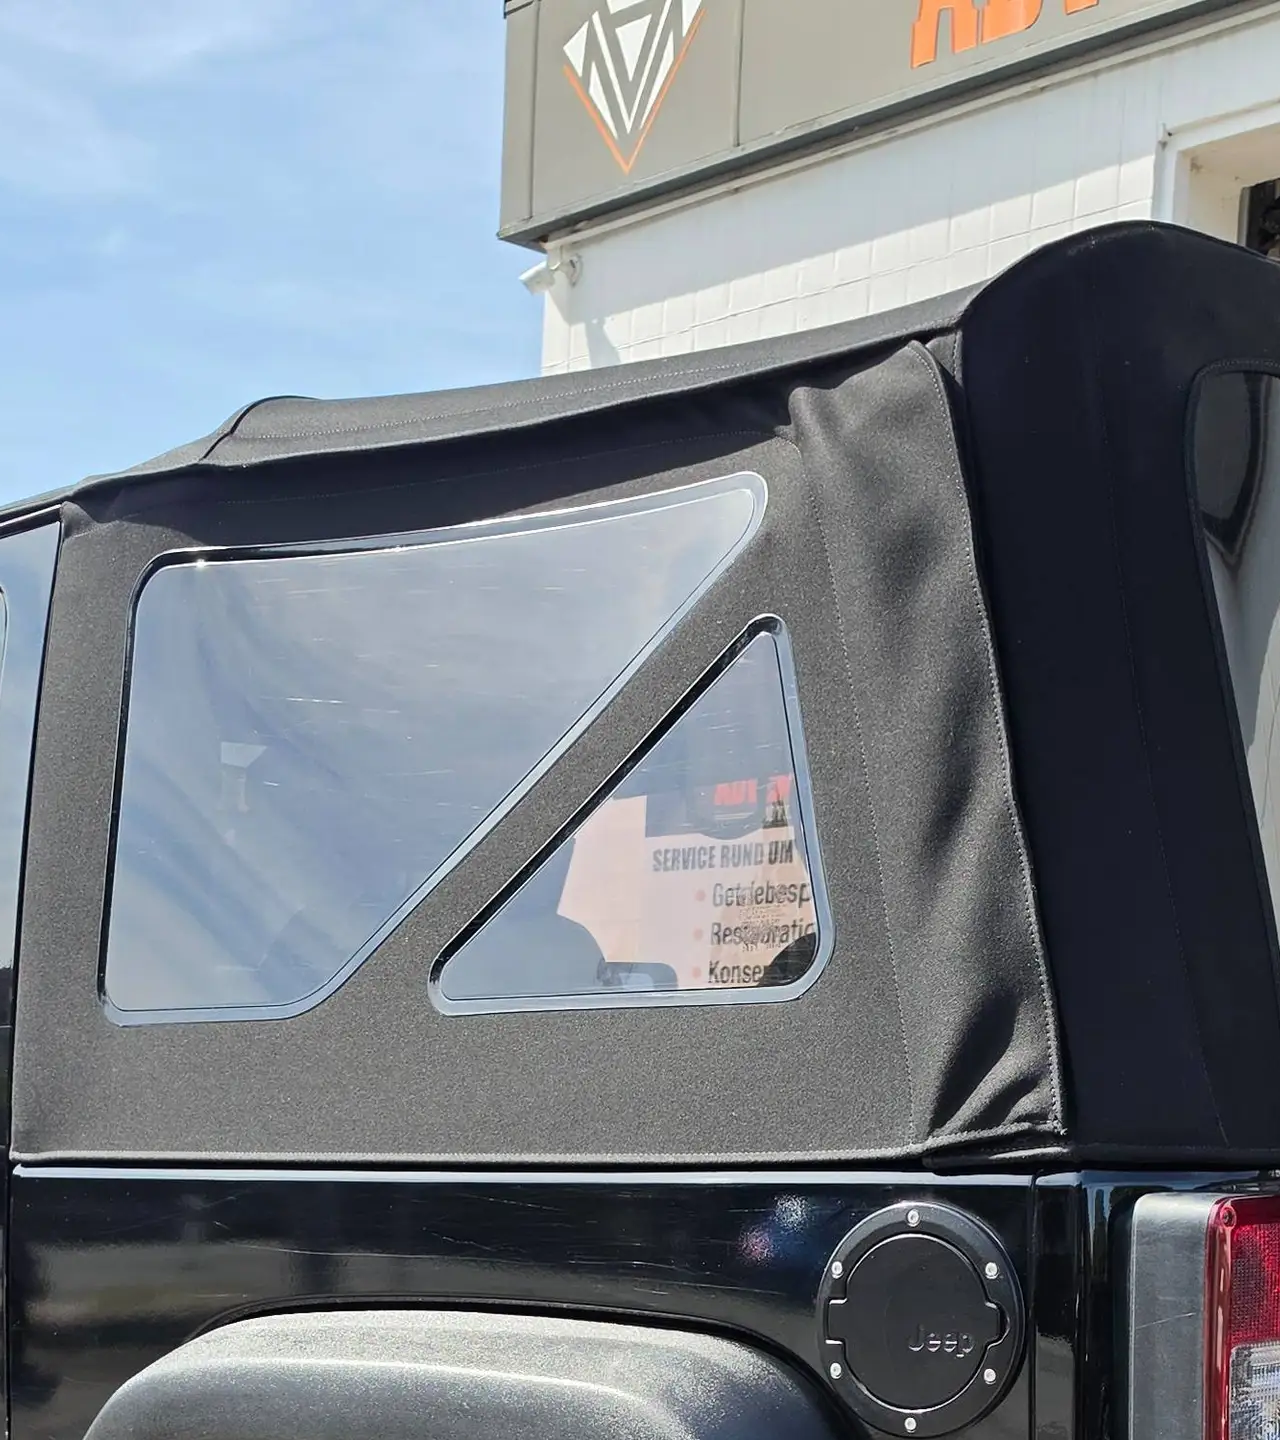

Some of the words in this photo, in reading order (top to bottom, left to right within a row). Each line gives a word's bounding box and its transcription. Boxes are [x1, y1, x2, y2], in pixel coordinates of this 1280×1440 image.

[652, 846, 716, 872] SERVICE
[720, 842, 764, 869] RUND
[767, 839, 794, 866] UM
[907, 1324, 976, 1358] Jeep
